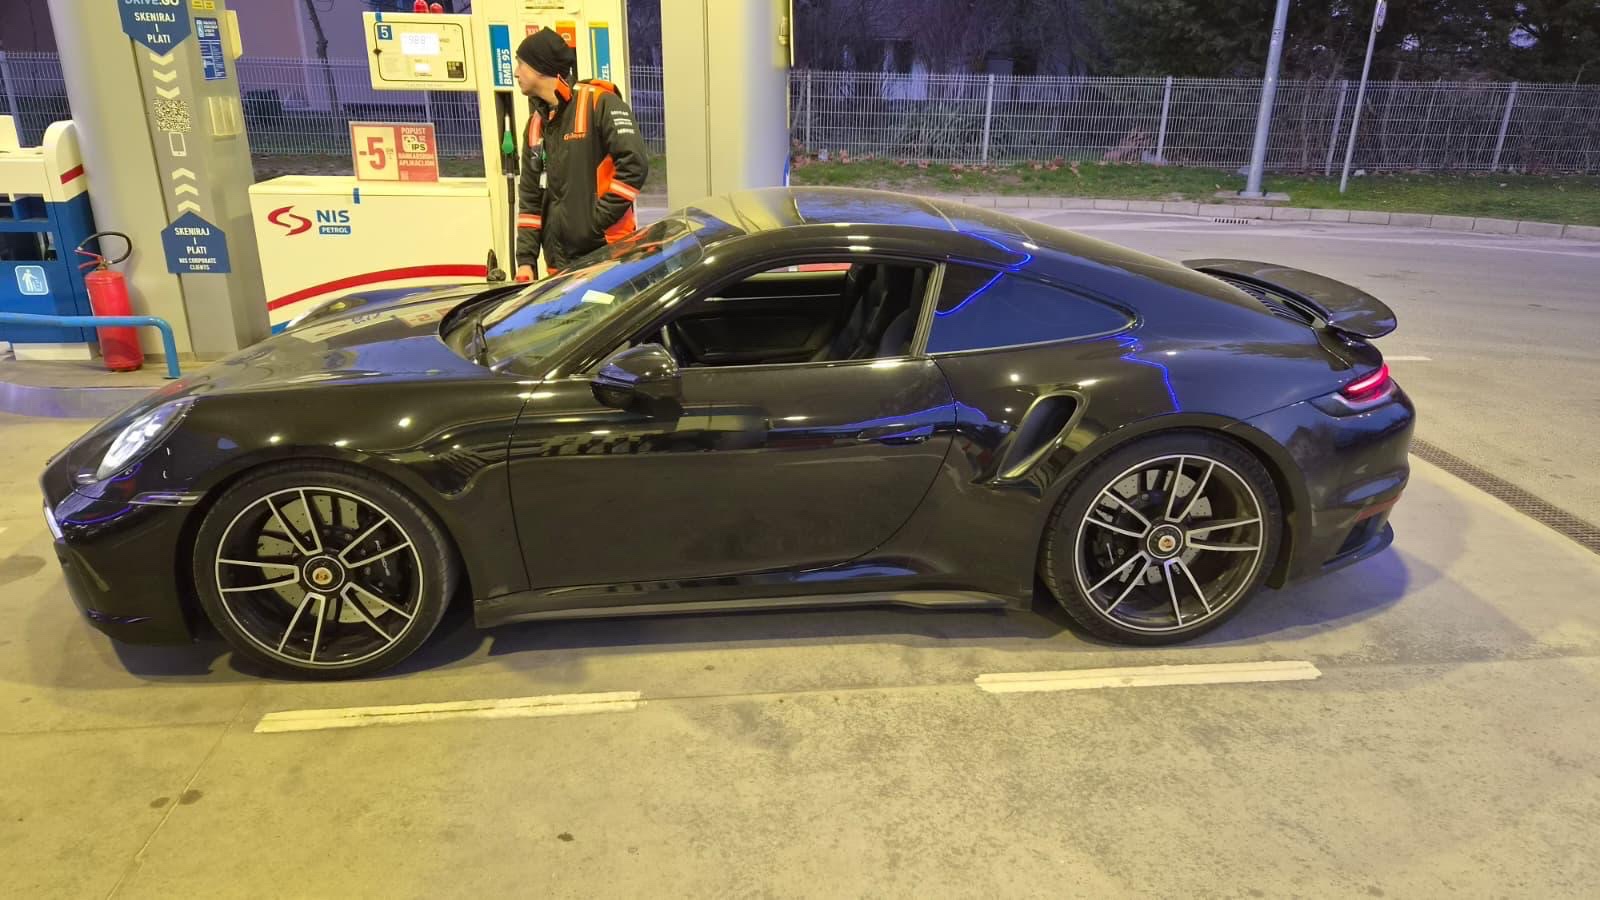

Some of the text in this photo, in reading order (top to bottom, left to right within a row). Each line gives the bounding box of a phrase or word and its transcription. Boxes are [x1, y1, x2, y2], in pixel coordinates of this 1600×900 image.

[134, 12, 176, 22] SKENIRAJ
[155, 23, 159, 32] I
[381, 26, 389, 38] 5
[147, 34, 171, 43] PLATI
[501, 48, 513, 85] BMB 95
[401, 127, 426, 135] POPUST
[358, 137, 387, 170] -5
[316, 210, 350, 223] NIS
[174, 227, 210, 236] SKENIRAJ
[321, 226, 349, 234] PETROL
[193, 236, 197, 245] I
[186, 246, 207, 255] PLATI
